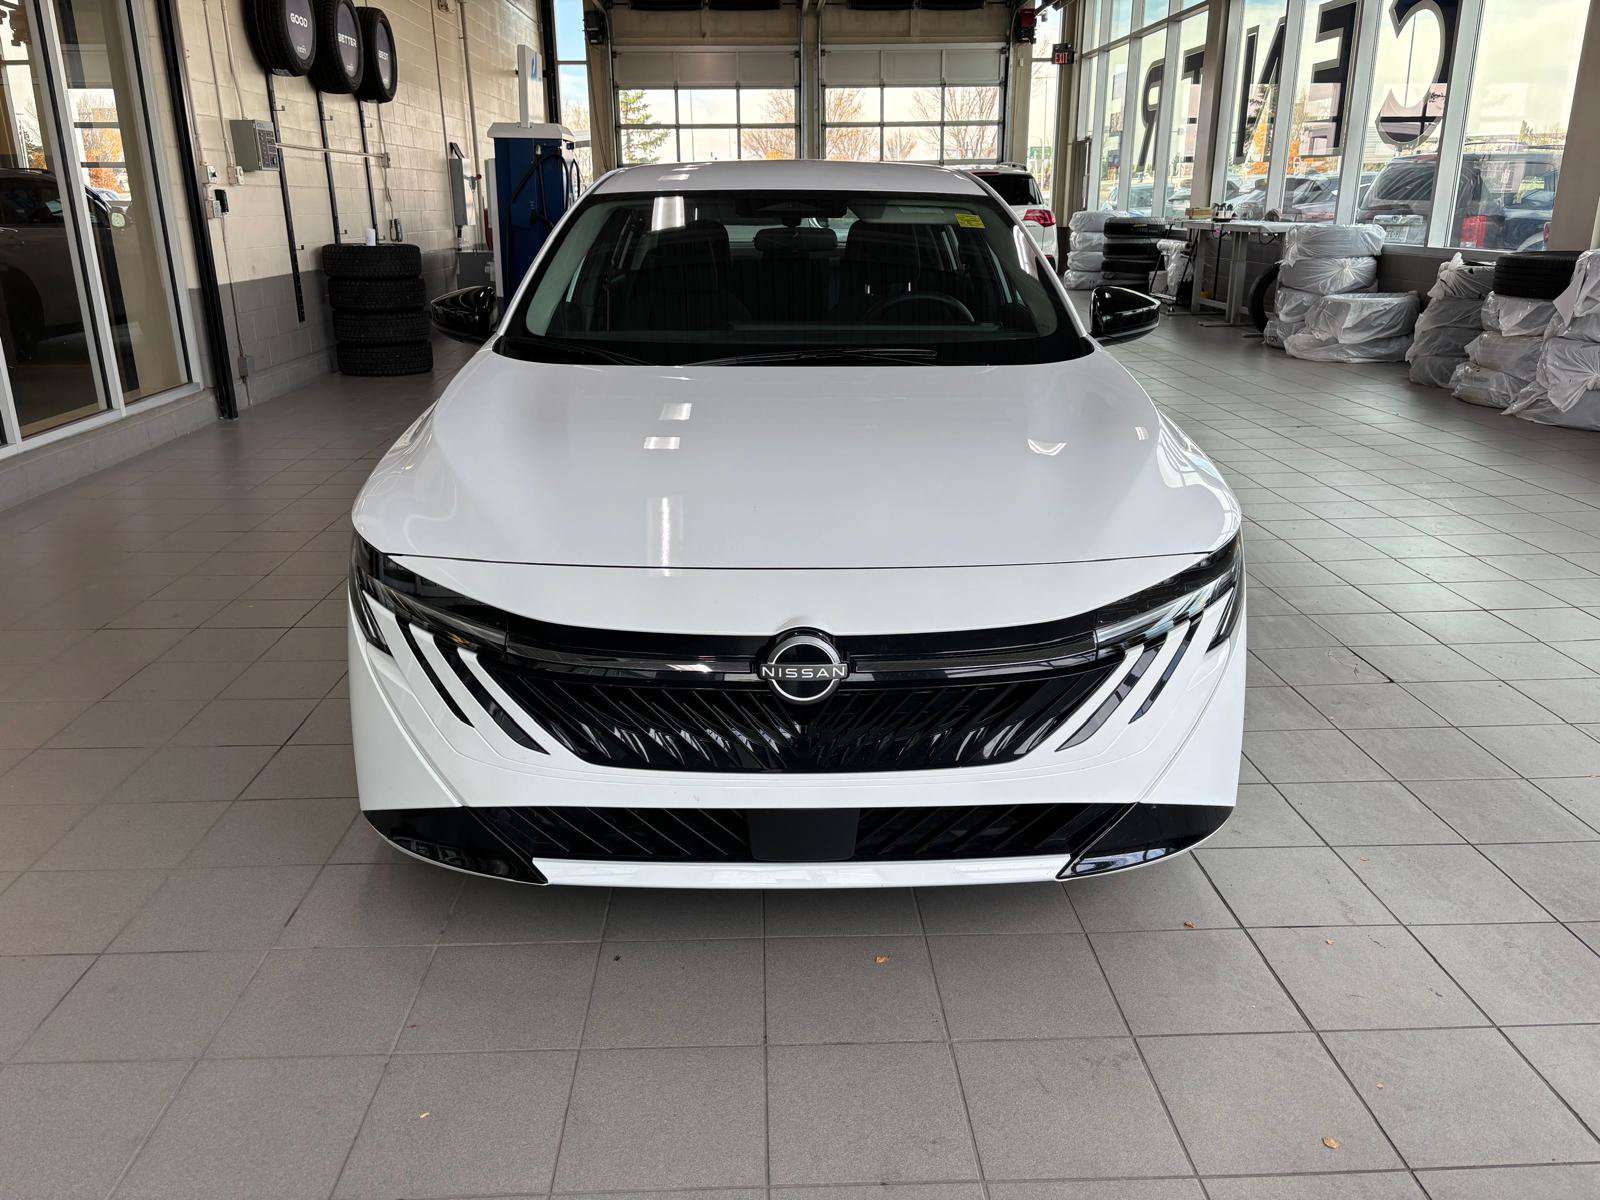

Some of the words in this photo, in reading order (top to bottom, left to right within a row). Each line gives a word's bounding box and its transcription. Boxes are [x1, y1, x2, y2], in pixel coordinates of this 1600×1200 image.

[290, 13, 308, 27] GOOD
[337, 33, 357, 47] BETTER
[378, 50, 389, 60] BEST
[1055, 52, 1069, 64] EXIT
[762, 666, 845, 678] NISSAN
